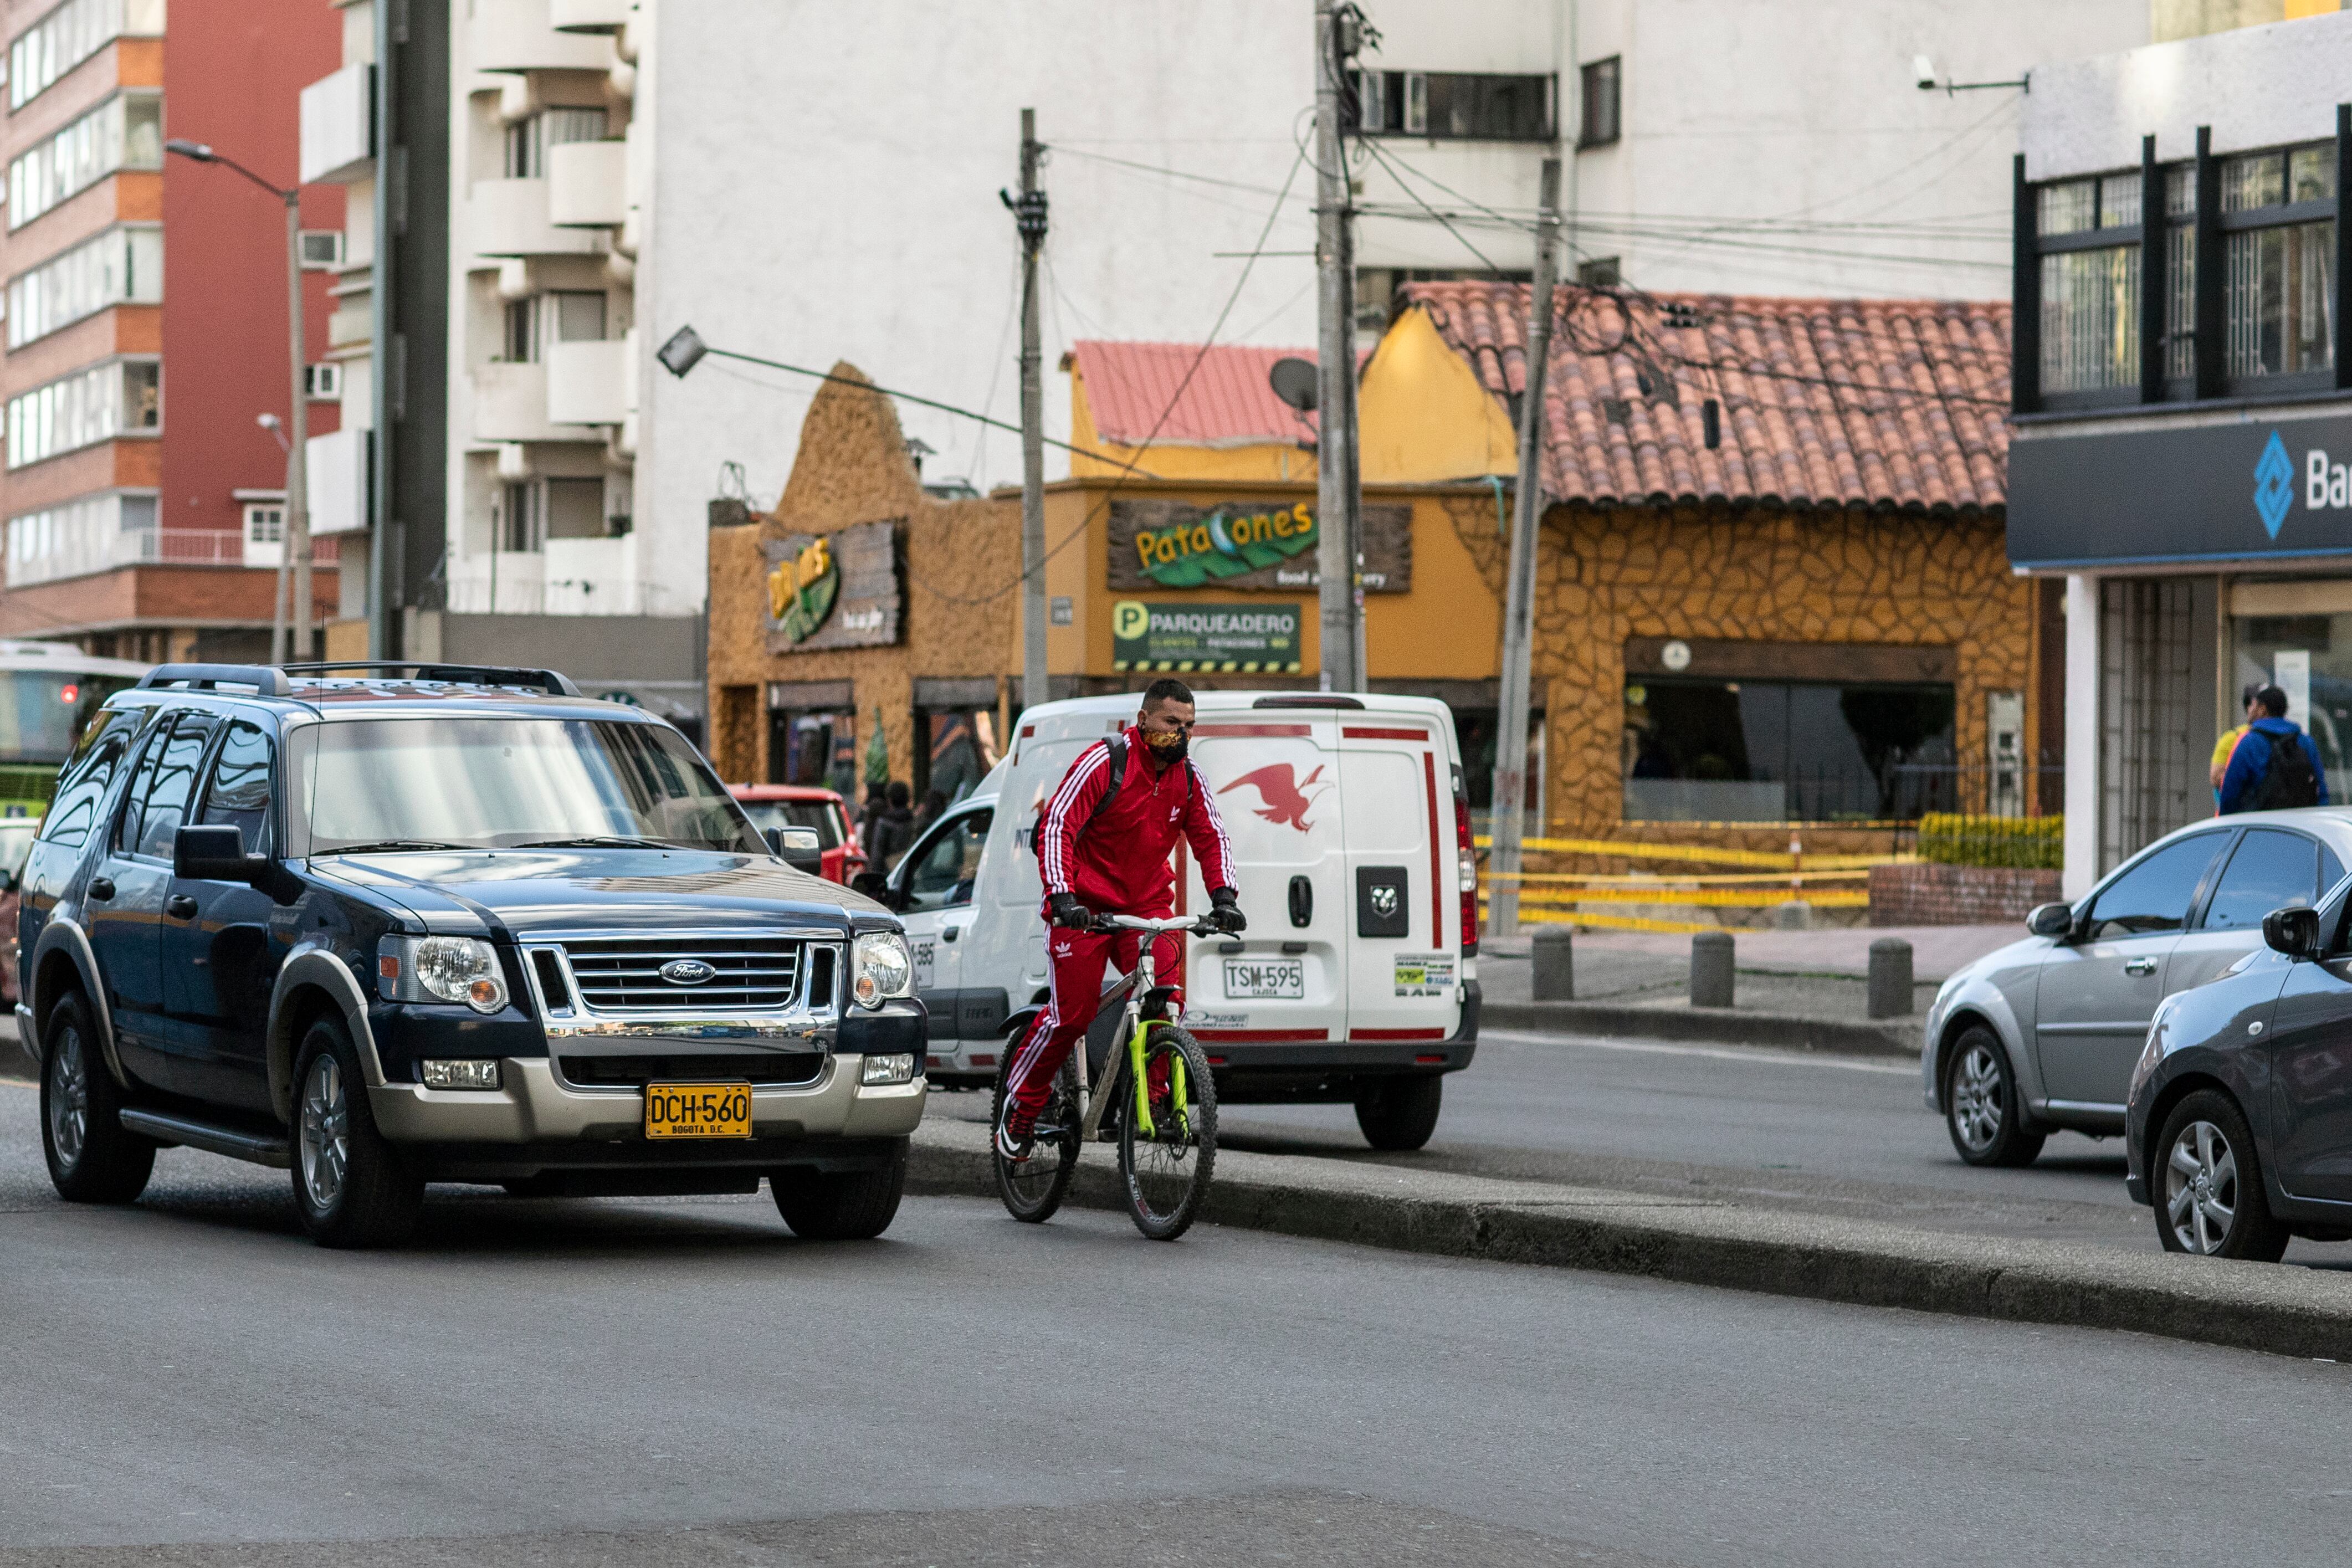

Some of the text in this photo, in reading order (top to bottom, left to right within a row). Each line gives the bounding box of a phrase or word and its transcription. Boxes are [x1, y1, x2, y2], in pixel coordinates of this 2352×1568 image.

[2307, 449, 2352, 510] Ba
[1122, 607, 1294, 634] P PARQUEADERO
[673, 964, 704, 977] Ford
[672, 1125, 705, 1134] BOGOTA
